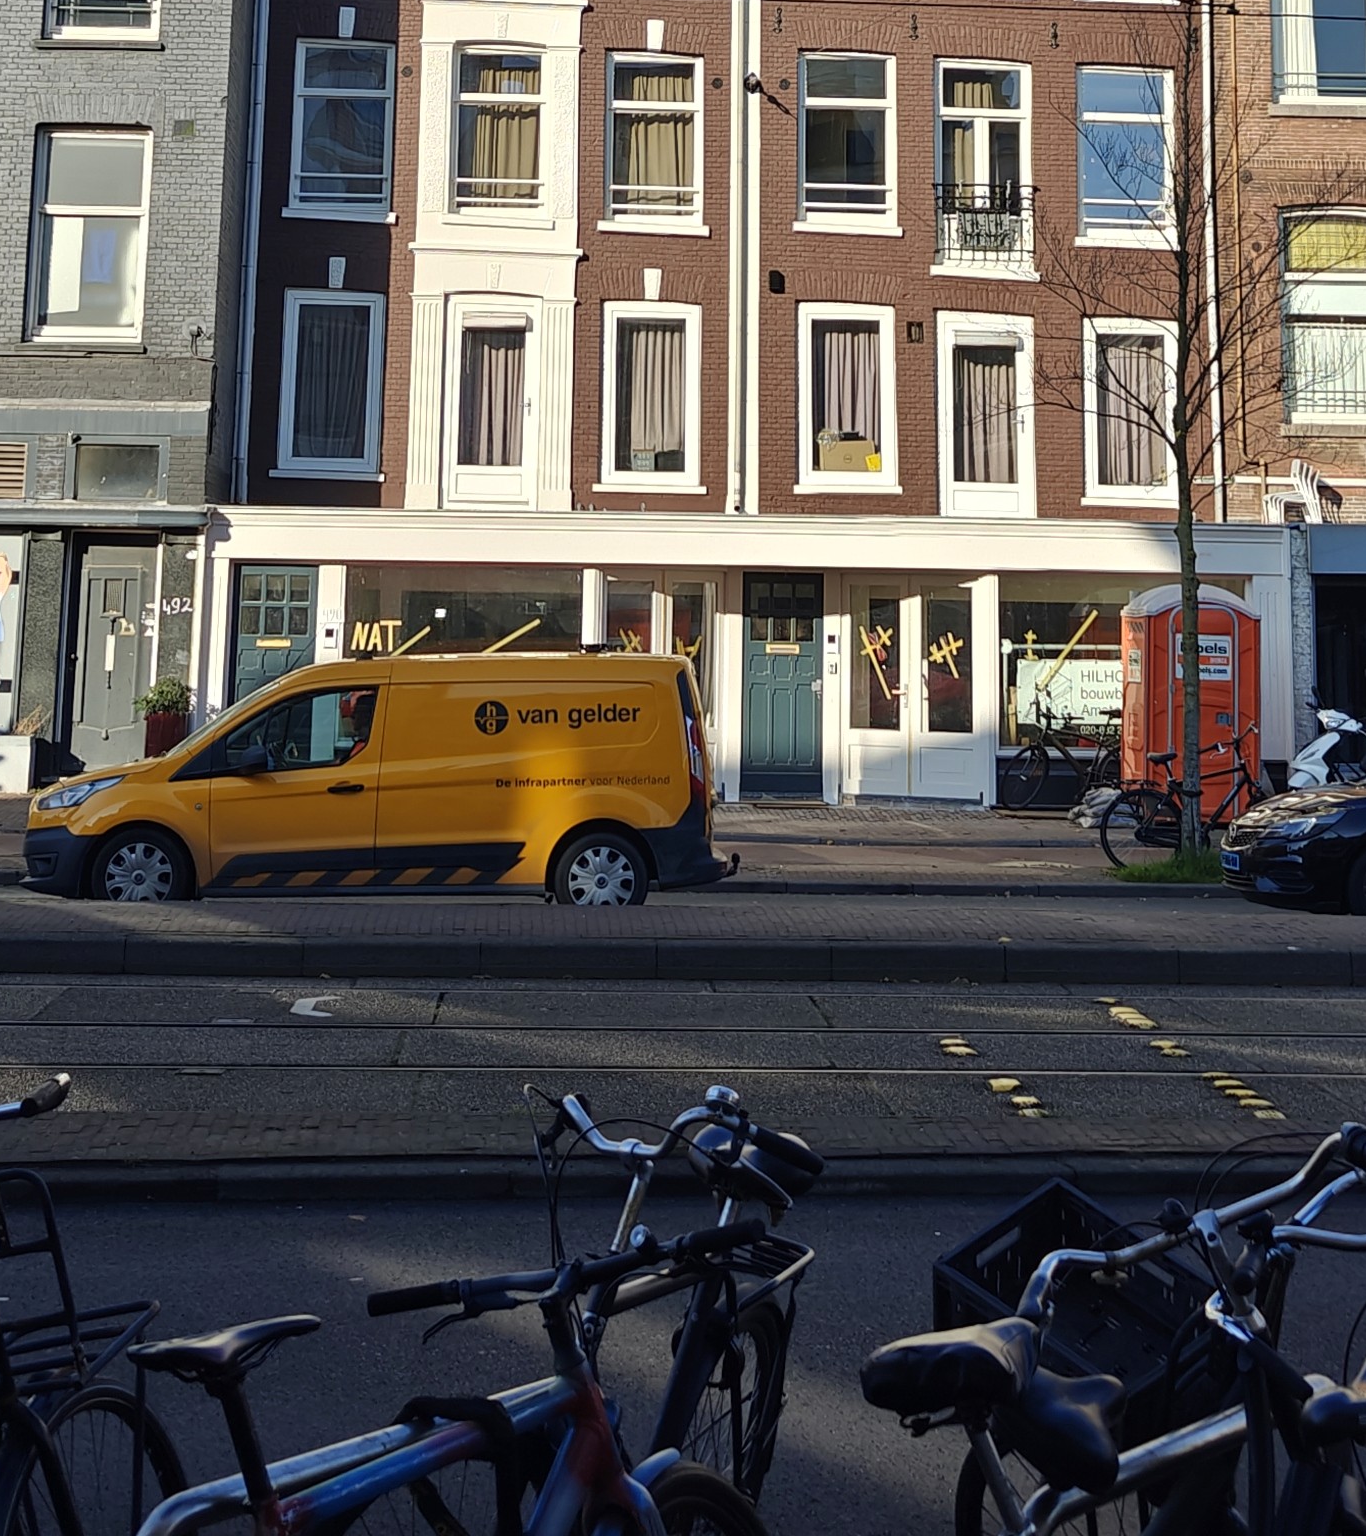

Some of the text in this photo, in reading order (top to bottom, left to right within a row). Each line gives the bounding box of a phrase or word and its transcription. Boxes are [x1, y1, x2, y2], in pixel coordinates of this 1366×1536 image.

[162, 597, 193, 615] 492
[350, 620, 403, 652] NAT
[517, 703, 641, 729] van gelder
[495, 775, 671, 789] De infrapartner voor Nederland
